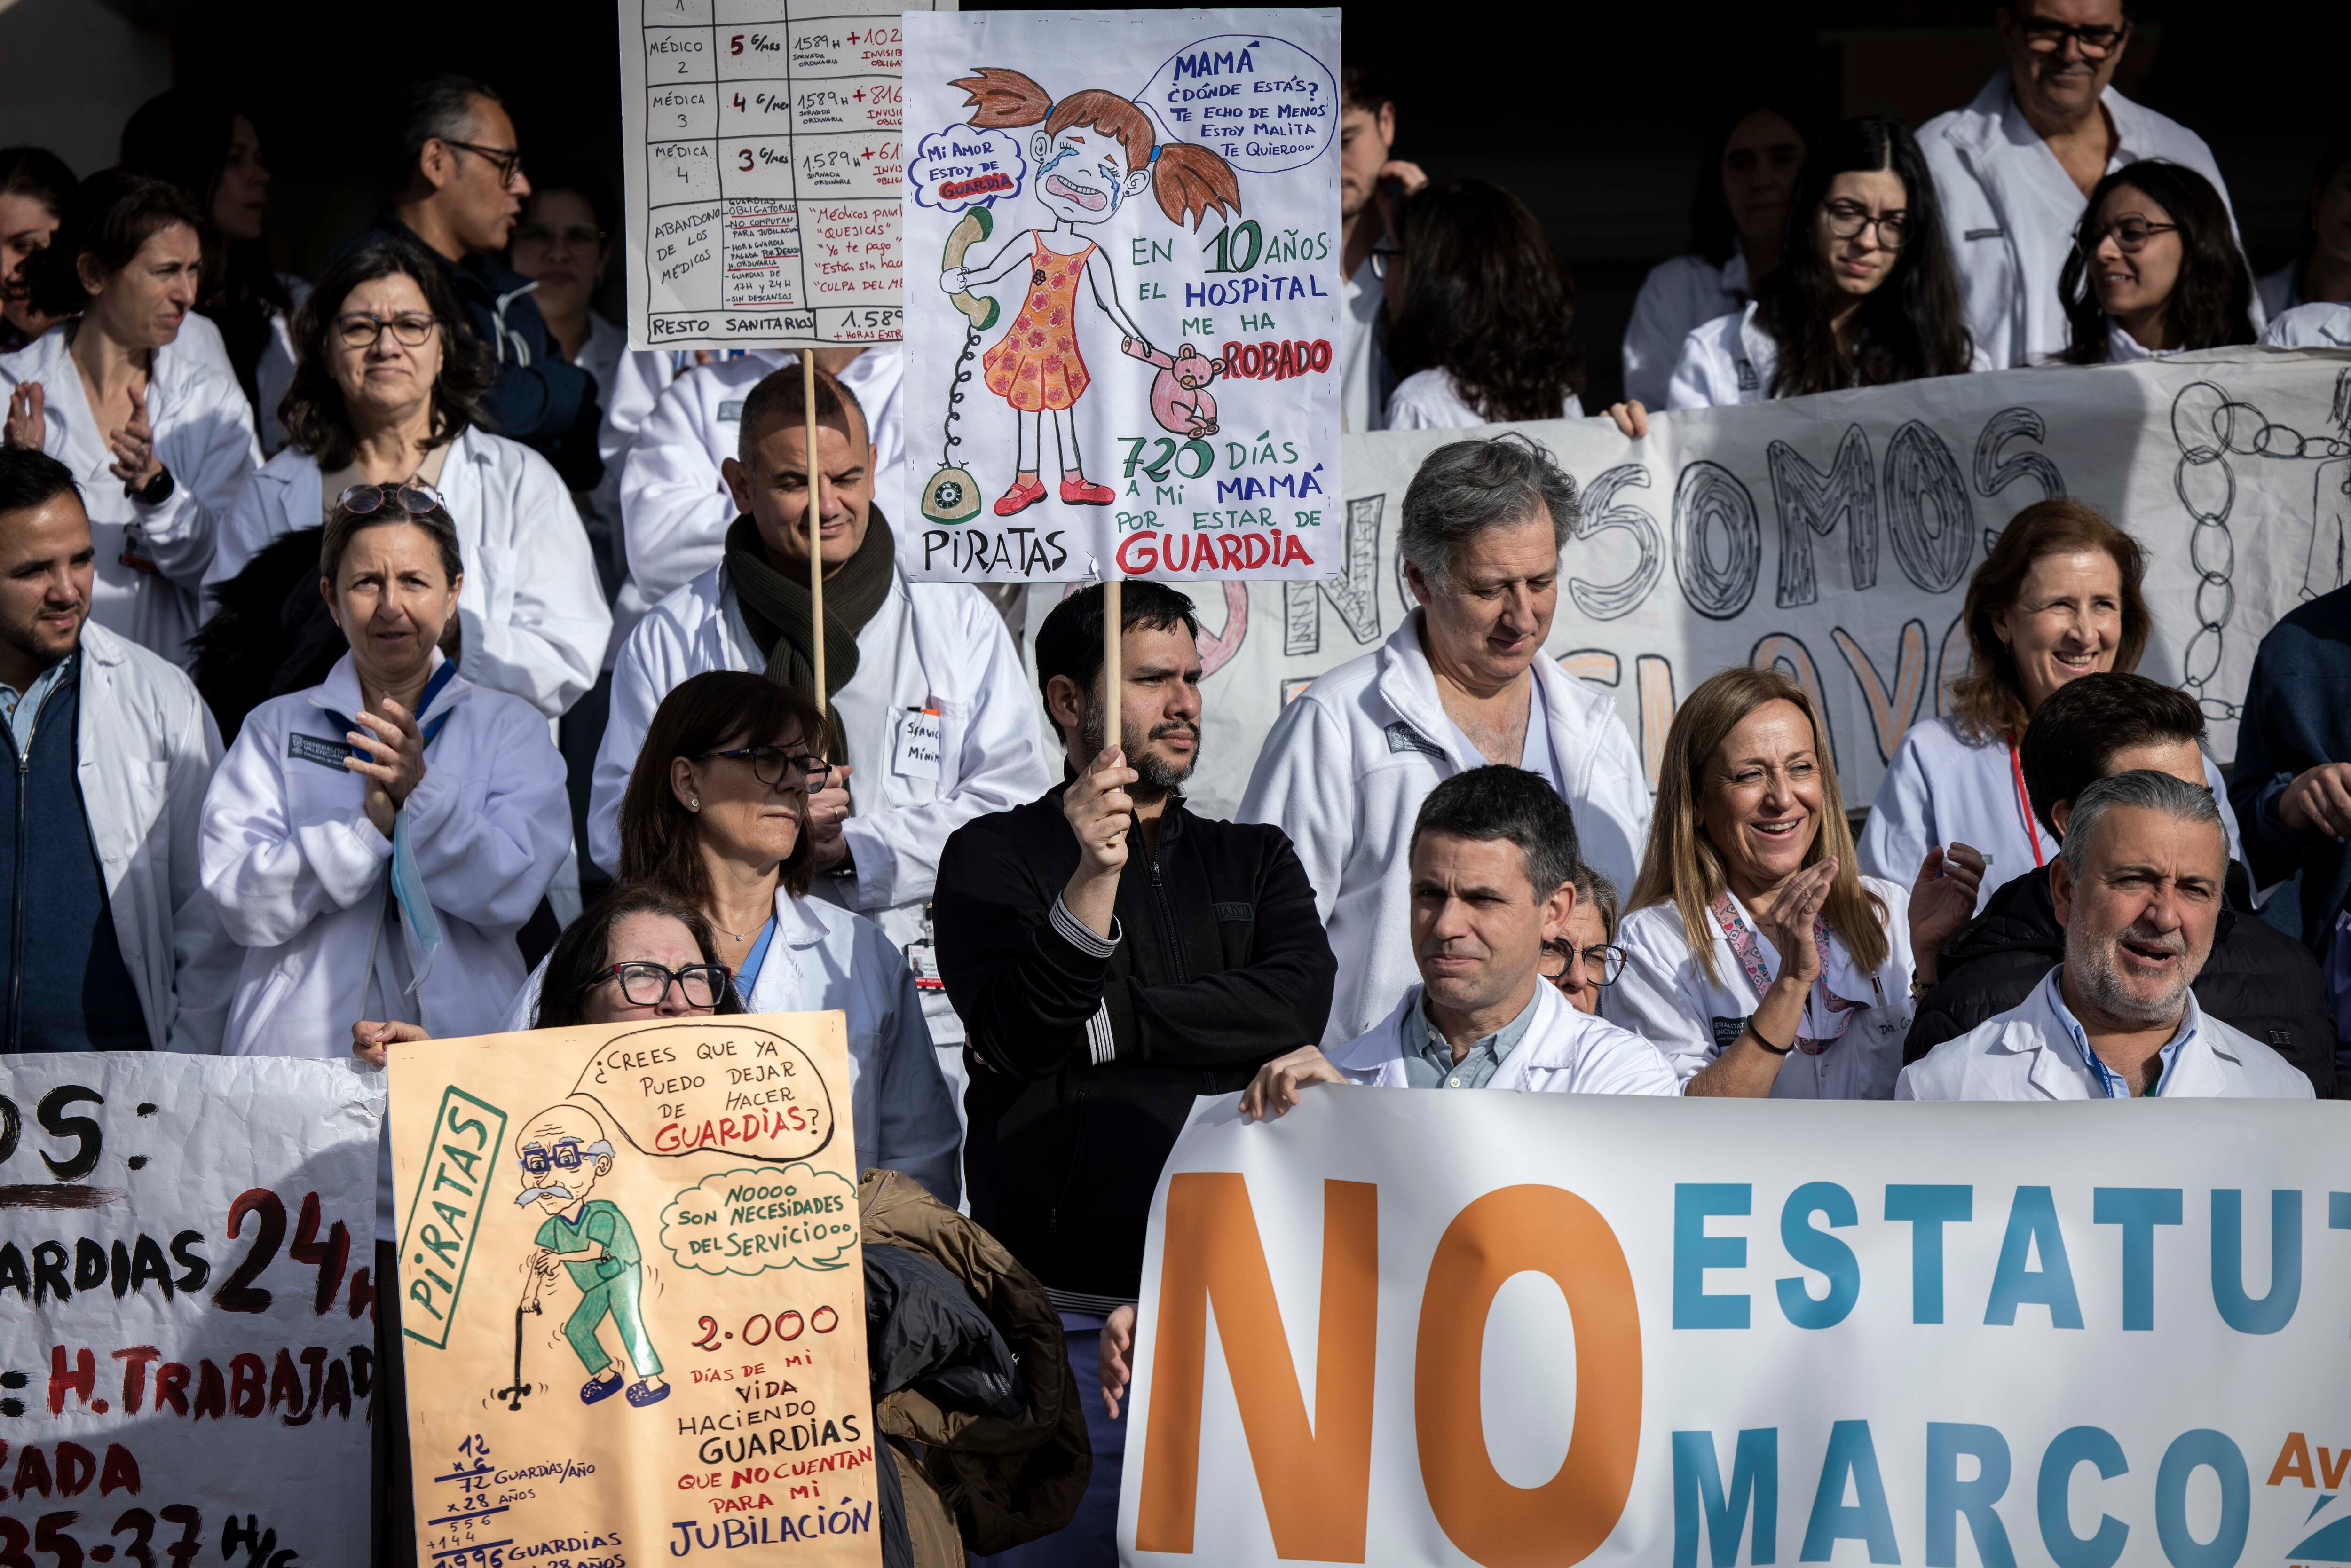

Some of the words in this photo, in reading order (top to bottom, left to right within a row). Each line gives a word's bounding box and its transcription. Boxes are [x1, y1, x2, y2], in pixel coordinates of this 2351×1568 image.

[650, 35, 702, 55] MÉDICO
[731, 34, 744, 55] 5
[751, 34, 780, 52] G/MES
[678, 62, 688, 73] 2
[1174, 40, 1260, 81] MAMÁ
[1167, 82, 1242, 102] ¿DÓNDE
[1254, 75, 1318, 102] ESTÁS?
[653, 91, 705, 107] MÉDICA
[733, 93, 746, 113] 4
[678, 114, 687, 127] 3
[1170, 107, 1192, 122] TE
[1204, 107, 1243, 118] ECHO
[1248, 108, 1269, 118] DE
[1278, 104, 1325, 118] MENOS
[1201, 124, 1244, 137] ESTOY
[655, 144, 708, 157] MÉDICA
[738, 149, 754, 172] 3
[759, 147, 789, 164] G/MES
[953, 142, 995, 157] AMOR
[1220, 143, 1239, 157] TE
[803, 151, 850, 172] 1.589
[929, 166, 973, 181] ESTOY
[978, 161, 999, 172] DE
[678, 167, 688, 183] 4
[655, 208, 720, 238] ABANDONO
[750, 217, 793, 226] COMPUTAN
[656, 244, 676, 261] DE
[688, 230, 707, 246] LOS
[755, 240, 784, 248] GUARDIA
[846, 241, 858, 253] te
[1132, 237, 1172, 266] EN
[1202, 218, 1262, 274] 10
[1263, 229, 1331, 266] AÑOS
[731, 252, 758, 260] PAGADA
[662, 249, 710, 284] MÉDICOS
[863, 280, 884, 290] DEL
[1138, 282, 1167, 301] EL
[748, 293, 792, 301] DESCANSOS
[653, 318, 709, 335] RESTO
[726, 317, 813, 330] SANITARIOS
[846, 331, 875, 339] HORAS
[1182, 317, 1215, 337] ME
[1239, 314, 1276, 332] HA
[1222, 339, 1333, 381] ROBADO
[1116, 437, 1215, 483] 720
[1125, 478, 1140, 497] A
[1216, 463, 1324, 504] MAMÁ
[1115, 510, 1166, 534] POR
[1192, 507, 1278, 531] ESTAR
[1294, 510, 1323, 528] DE
[303, 741, 347, 755] GENERALITAT
[594, 1047, 677, 1084] ¿CREES
[697, 1041, 737, 1060] QUE
[754, 1041, 778, 1058] YA
[640, 1076, 705, 1098] PUEDO
[726, 1061, 796, 1085] DEJAR
[658, 1103, 686, 1119] DE
[726, 1087, 796, 1111] HACER
[678, 1210, 717, 1225] SON
[689, 1237, 723, 1255] DEL
[691, 1305, 839, 1351] 2.000
[741, 1363, 766, 1378] DE
[1135, 1171, 1644, 1568] NO
[1672, 1181, 2351, 1337] ESTATU
[48, 1344, 373, 1429] H.TRABAJAD
[458, 1434, 490, 1458] 12
[0, 1439, 142, 1501] ADA
[473, 1457, 489, 1471] 6
[678, 1473, 722, 1490] QUE
[731, 1467, 769, 1489] NO
[773, 1445, 873, 1479] CUENTAN
[2266, 1431, 2351, 1490] Av
[456, 1477, 491, 1493] 72
[1672, 1417, 2251, 1568] MARCO
[498, 1489, 536, 1505] AÑOS
[708, 1493, 774, 1514] PARA
